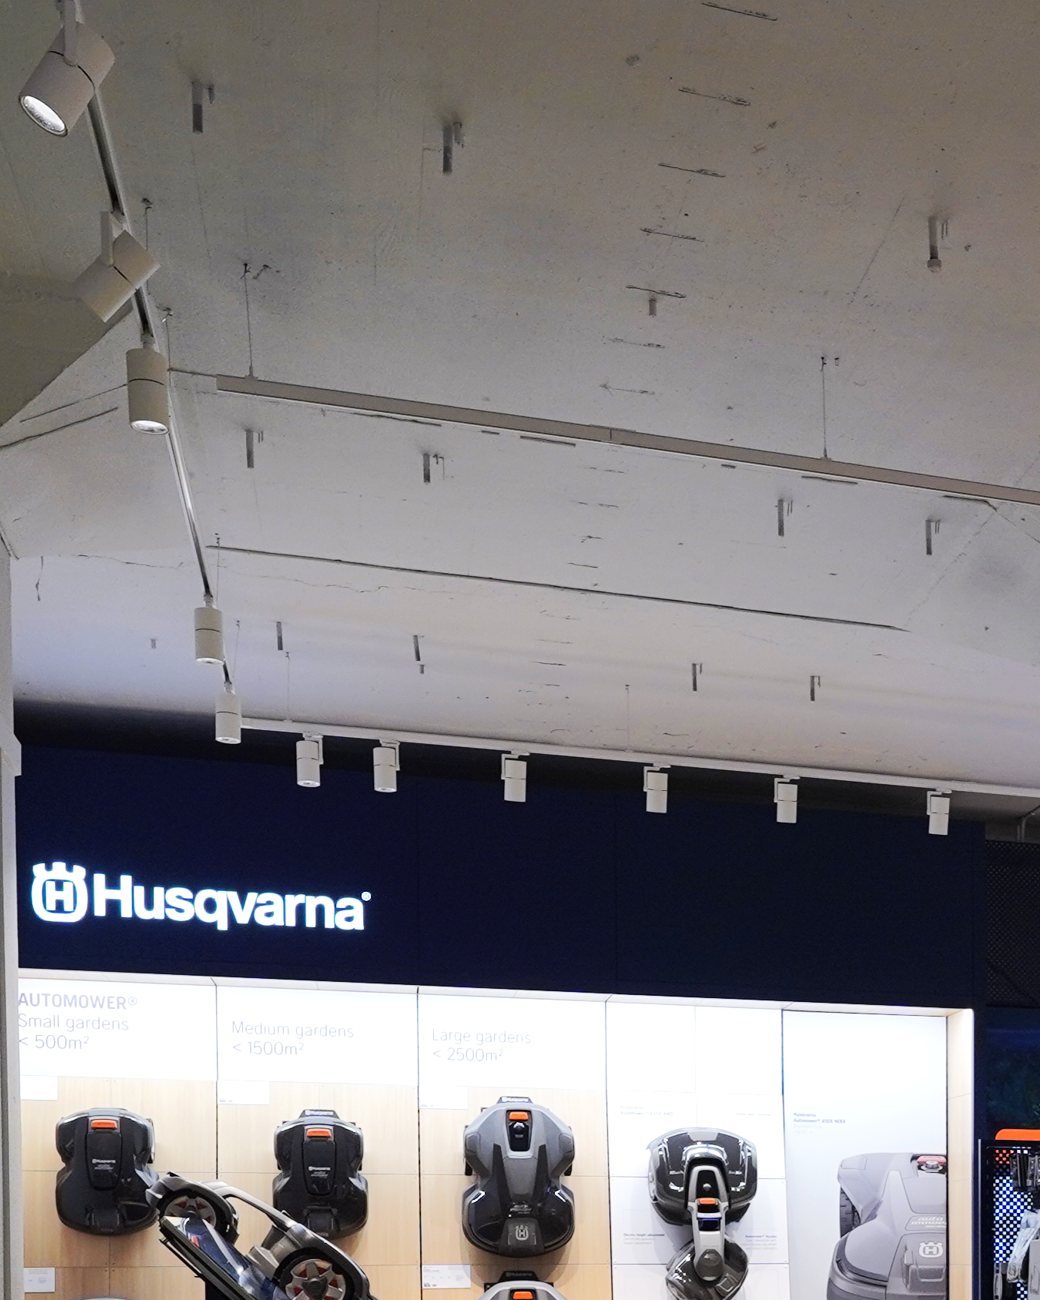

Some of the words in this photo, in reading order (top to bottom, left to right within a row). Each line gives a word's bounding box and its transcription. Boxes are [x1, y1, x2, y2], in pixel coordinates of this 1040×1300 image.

[18, 1013, 60, 1028] Small
[65, 1017, 129, 1032] gardens
[231, 1020, 290, 1036] Medium
[295, 1023, 354, 1038] gardens
[432, 1027, 471, 1044] Large
[475, 1030, 532, 1045] gardens
